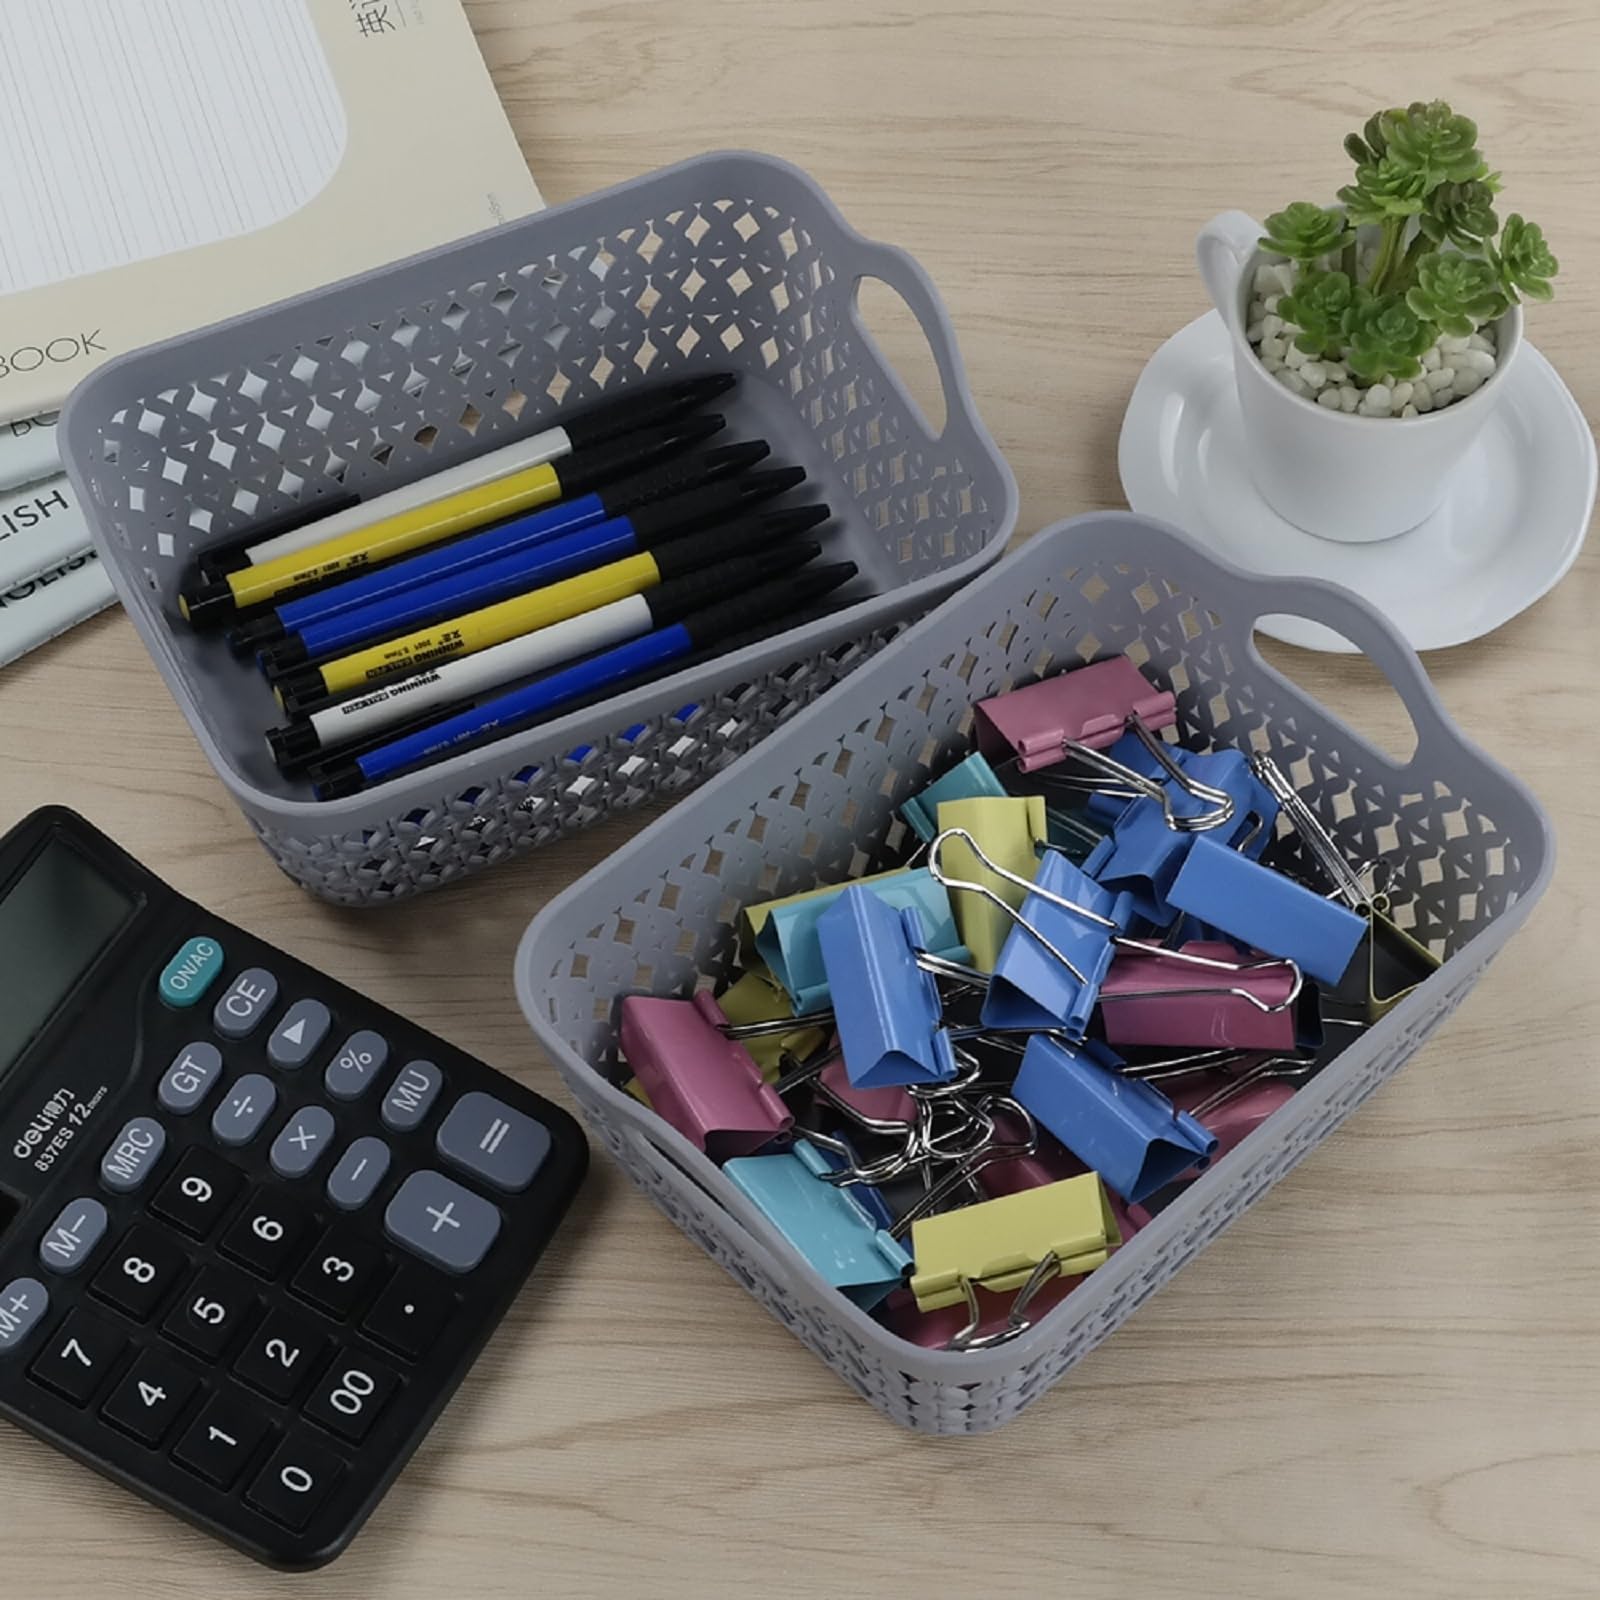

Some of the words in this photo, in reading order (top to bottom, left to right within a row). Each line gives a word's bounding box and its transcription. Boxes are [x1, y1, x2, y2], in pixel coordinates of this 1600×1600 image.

[350, 0, 396, 37] 英
[390, 673, 442, 696] WINNING
[170, 943, 214, 990] ON/AC
[226, 979, 266, 1017] CE
[171, 1055, 207, 1094] GT
[391, 1070, 429, 1112] MU
[34, 1127, 74, 1172] 837ES
[106, 1128, 154, 1179] MRC
[181, 1177, 212, 1202] 9
[252, 1215, 284, 1241] 6
[123, 1257, 156, 1283] 8
[322, 1256, 355, 1282] 3
[193, 1296, 225, 1324] 5
[61, 1338, 92, 1368] 7
[265, 1338, 300, 1368] 2
[138, 1381, 167, 1407] 4
[330, 1370, 375, 1414] 00
[209, 1426, 238, 1447] 1
[281, 1466, 313, 1492] 0
